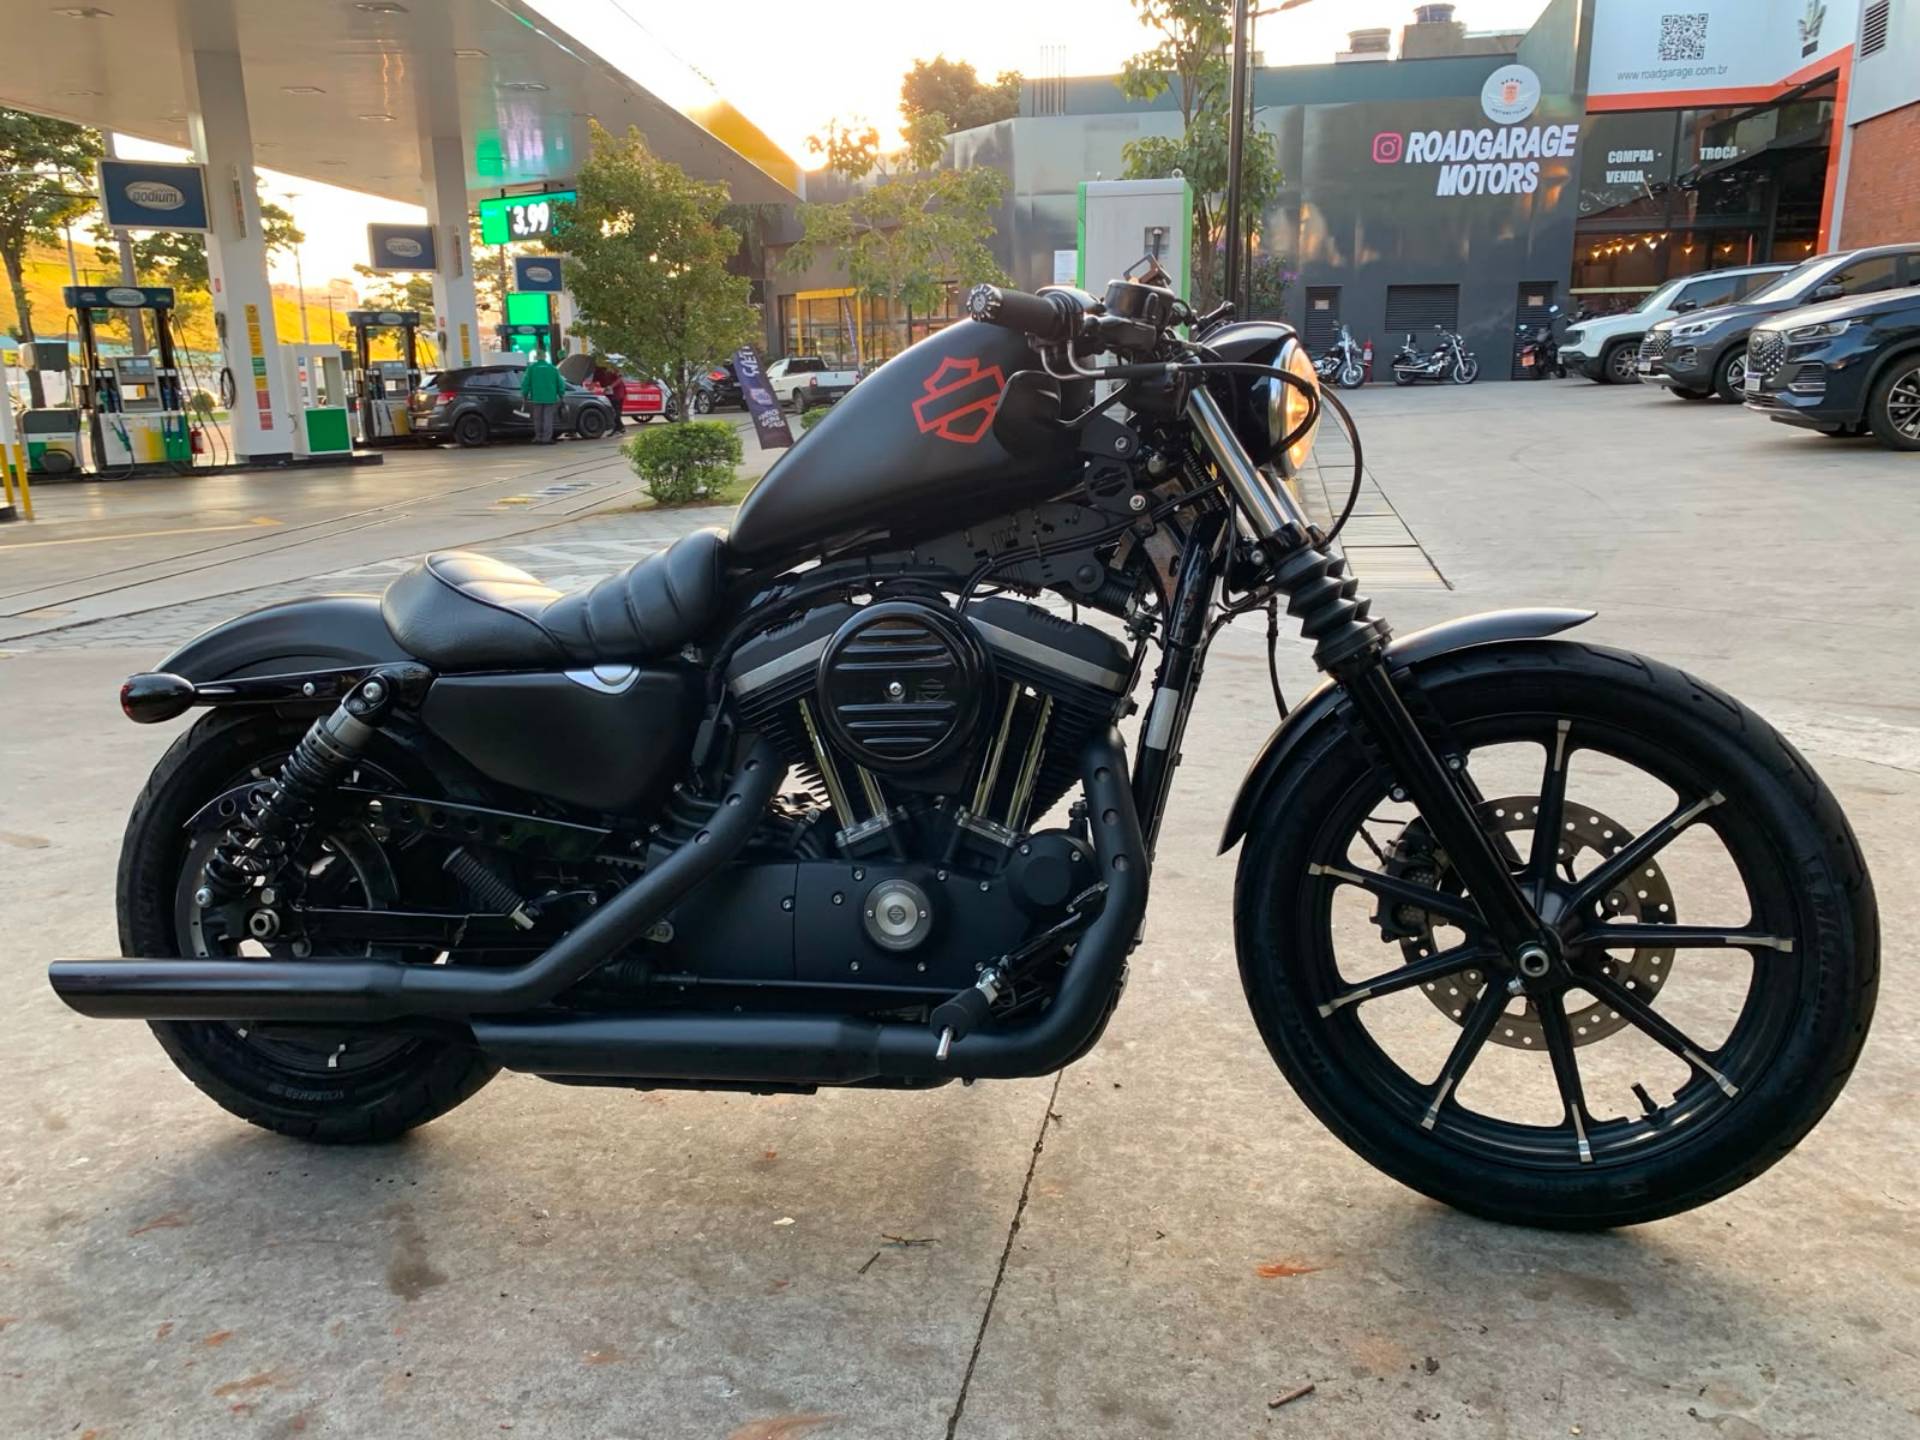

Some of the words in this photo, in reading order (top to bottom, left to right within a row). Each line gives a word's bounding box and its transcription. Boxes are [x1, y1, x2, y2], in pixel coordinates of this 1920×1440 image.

[1617, 65, 1728, 81] www.roadgarage.com.br
[1405, 125, 1579, 163] ROADGARAGE
[1608, 150, 1654, 163] COMPRA
[1700, 146, 1738, 160] TROCA
[1437, 162, 1539, 196] MOTORS
[1606, 170, 1644, 183] VENDA
[513, 202, 549, 235] 3,99
